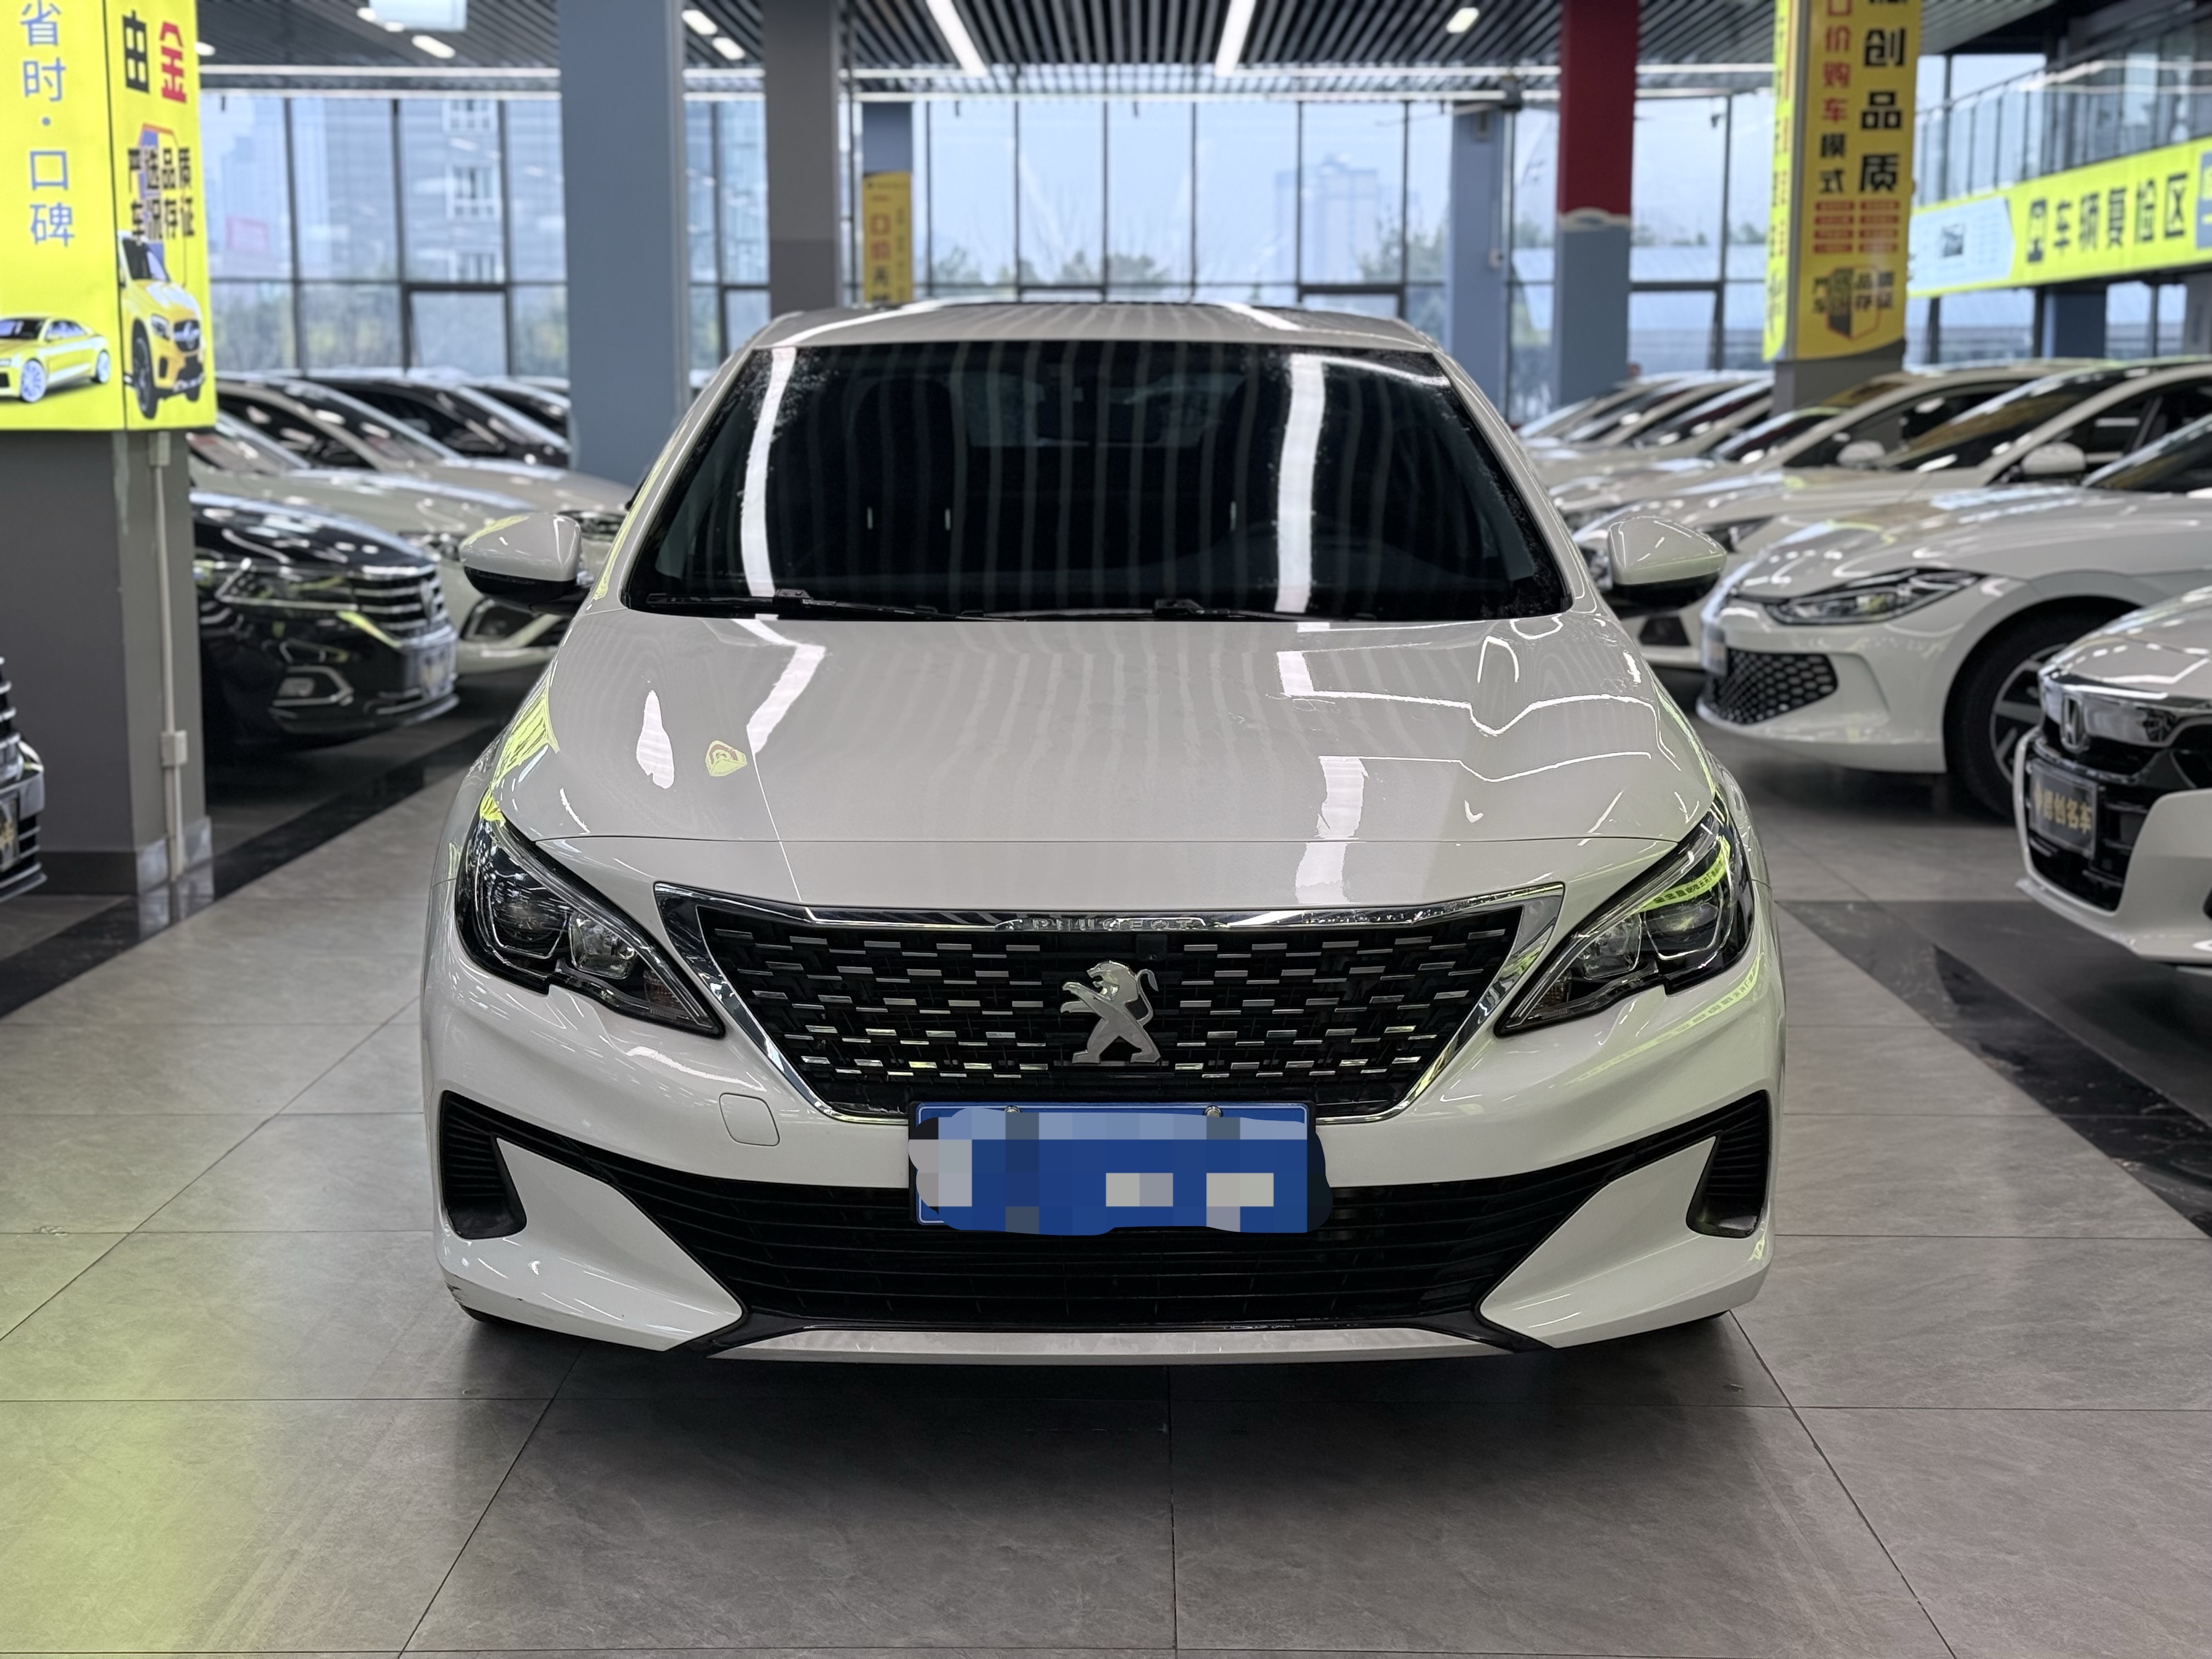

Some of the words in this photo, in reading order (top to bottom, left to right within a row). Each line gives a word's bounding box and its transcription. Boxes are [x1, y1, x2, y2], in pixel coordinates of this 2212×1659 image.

[122, 9, 150, 94] 由
[1859, 0, 1909, 193] 创品质
